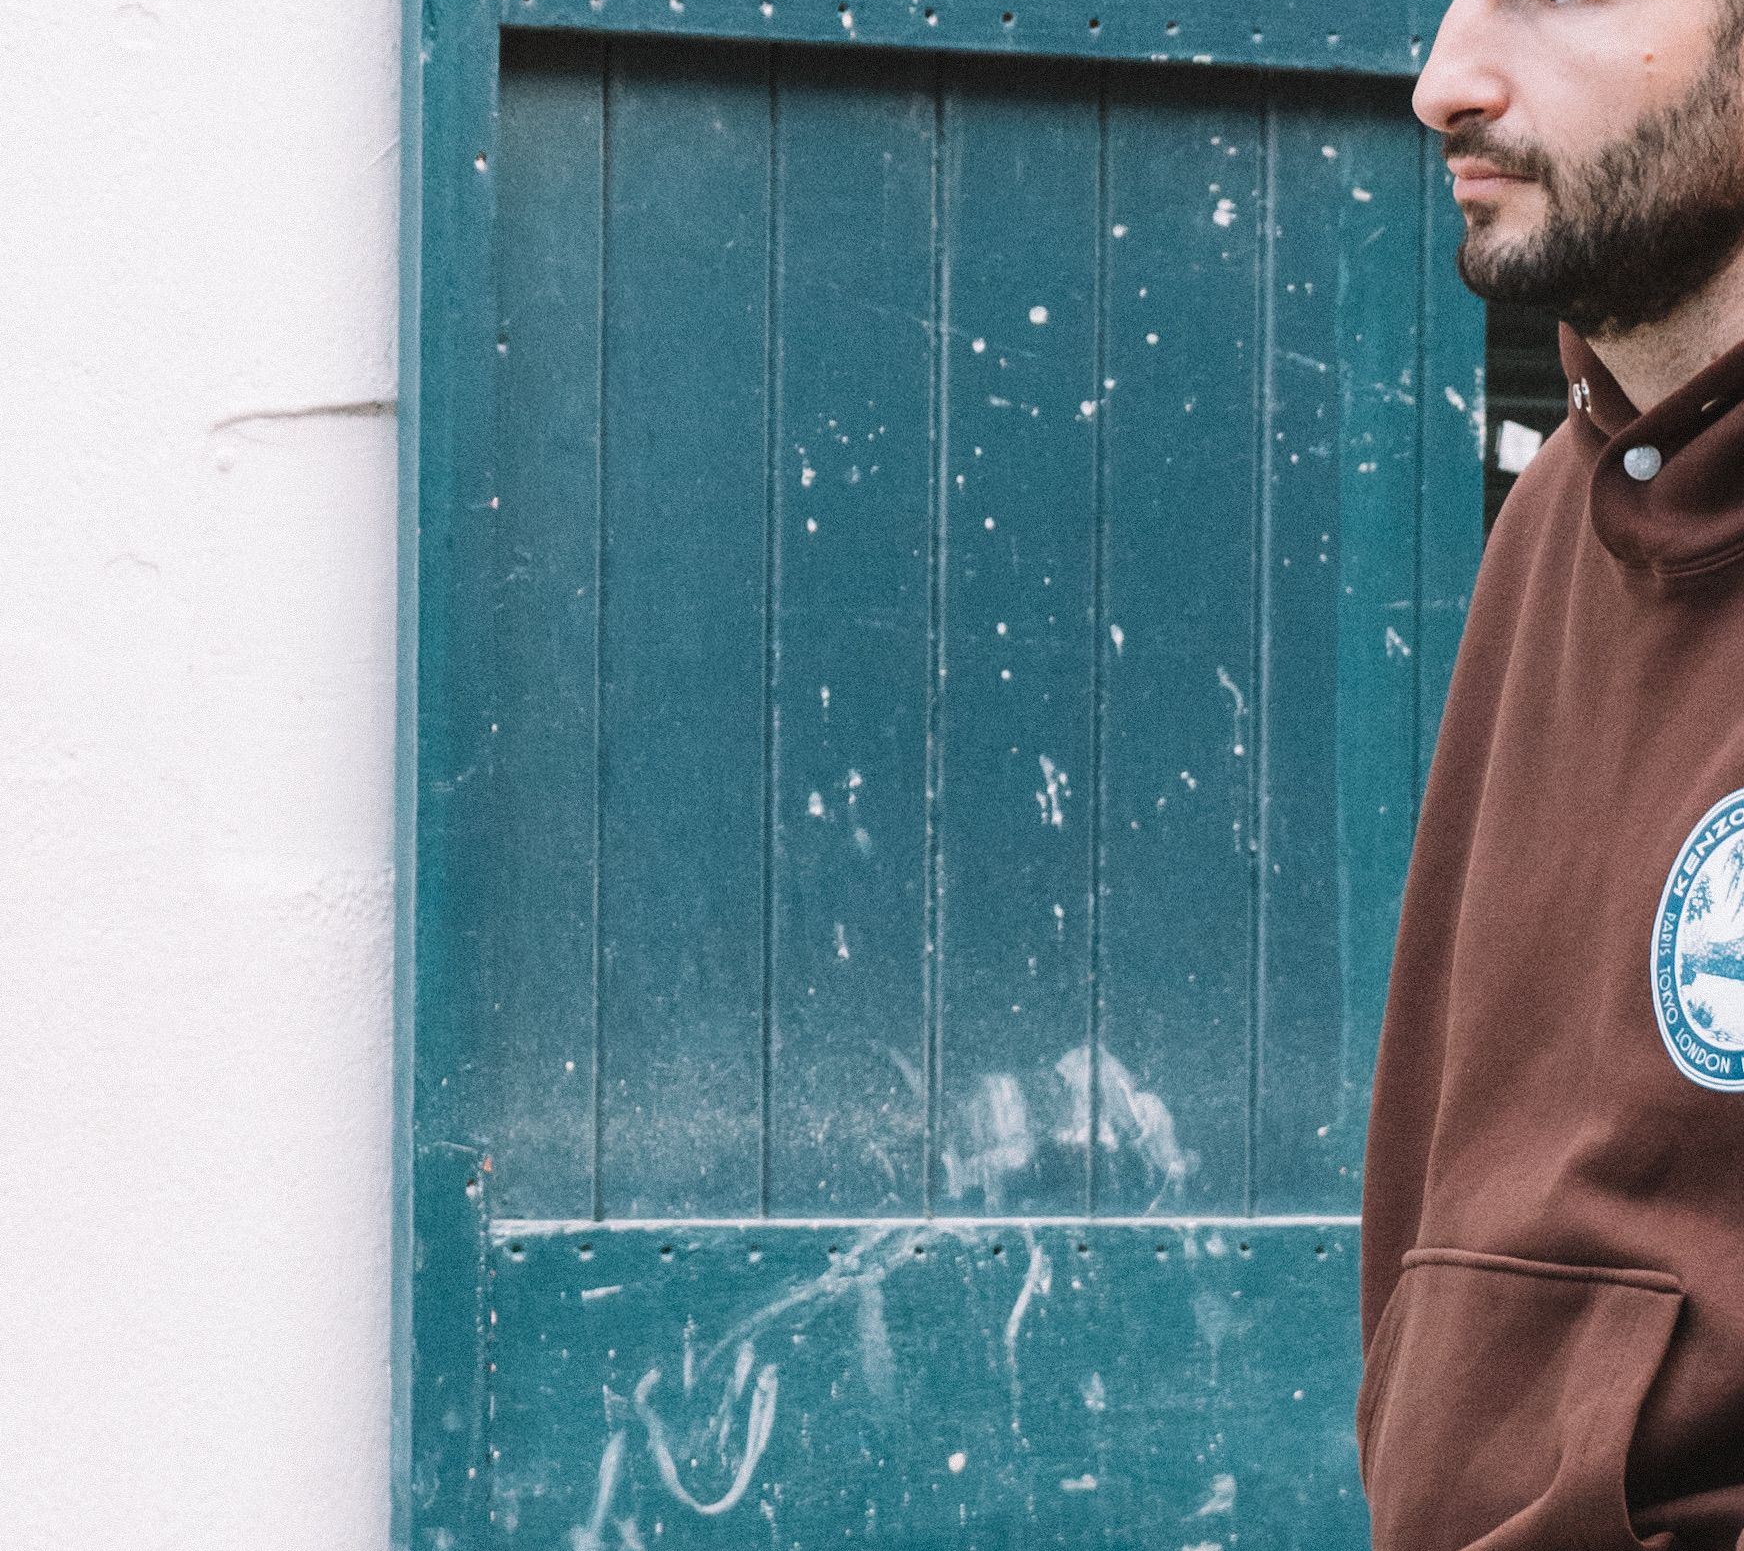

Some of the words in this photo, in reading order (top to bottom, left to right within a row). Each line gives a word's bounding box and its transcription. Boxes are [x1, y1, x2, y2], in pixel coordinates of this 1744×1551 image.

[1658, 912, 1678, 956] PARIS
[1658, 966, 1680, 1025] TOKYO
[1675, 1027, 1731, 1074] LONDON
